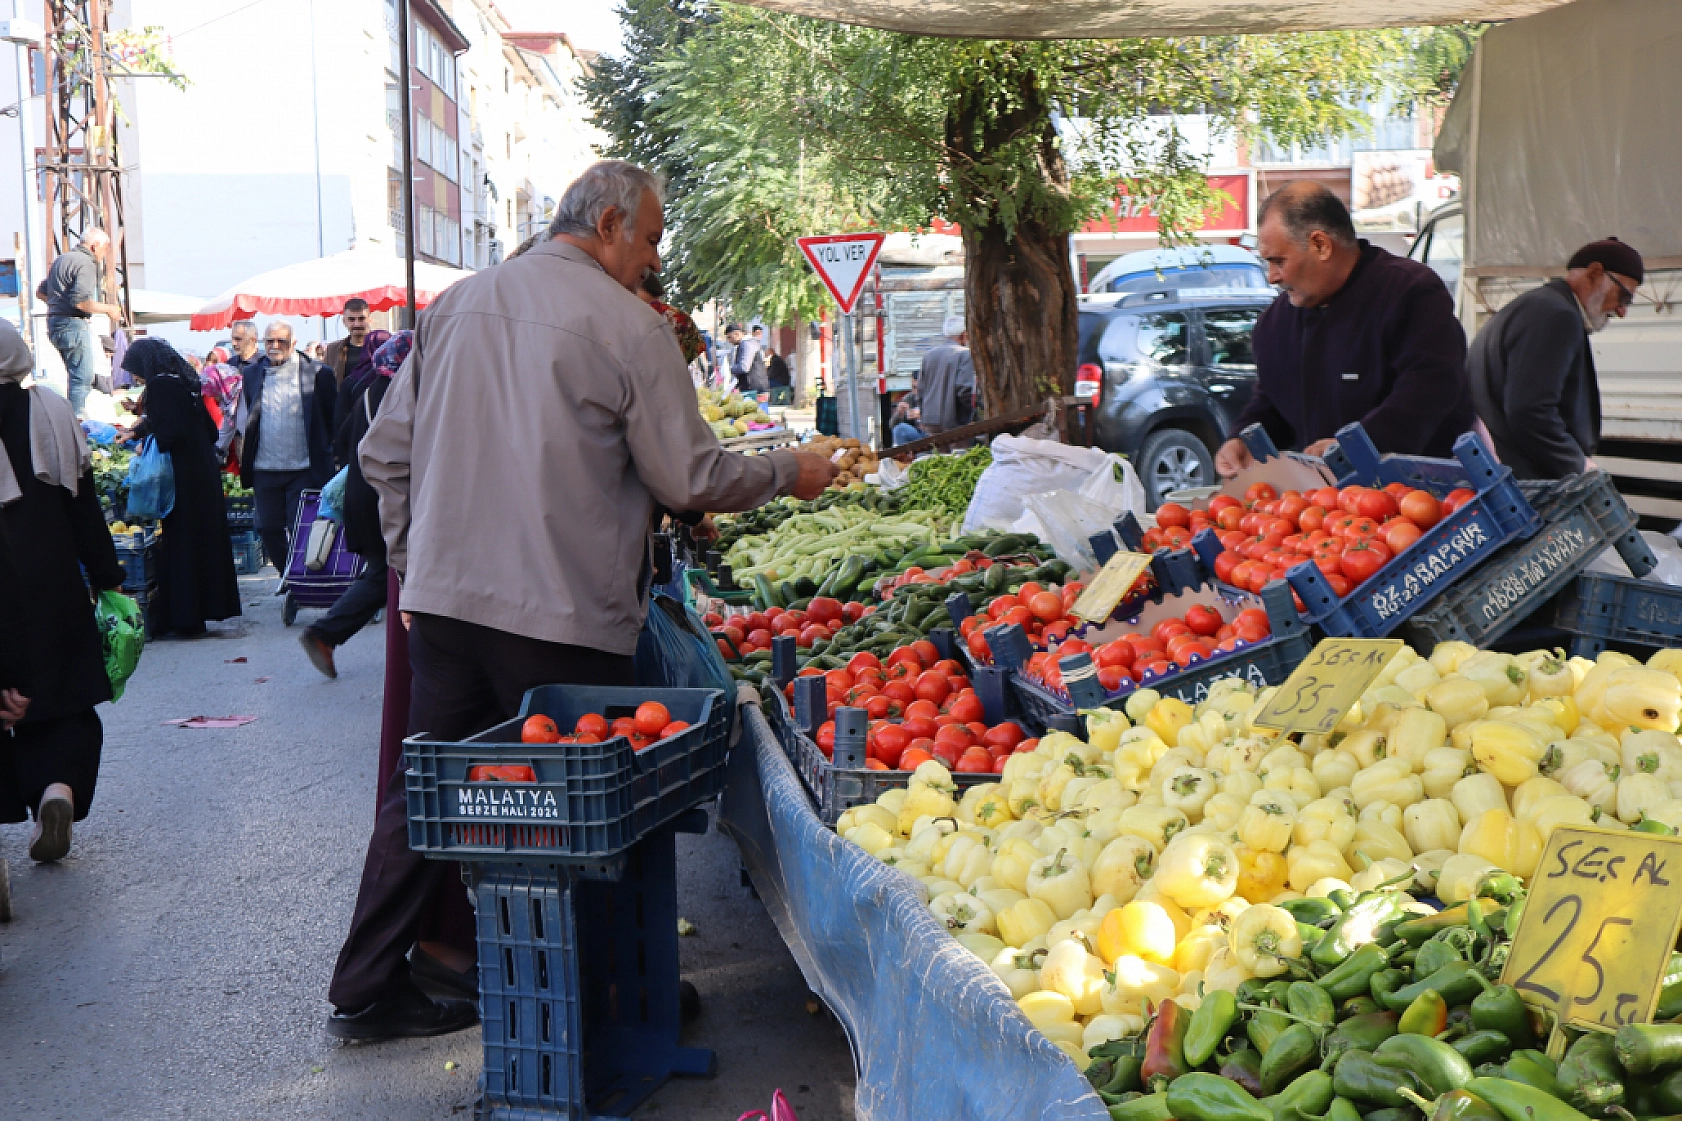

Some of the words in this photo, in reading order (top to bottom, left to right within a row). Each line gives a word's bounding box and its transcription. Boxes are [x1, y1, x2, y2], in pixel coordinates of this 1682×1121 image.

[817, 247, 840, 262] YOL
[843, 245, 866, 261] VER
[1422, 533, 1489, 585] MALATYA
[1273, 676, 1334, 716] 35
[458, 788, 557, 806] MALATYA
[1513, 893, 1633, 1005] 25
